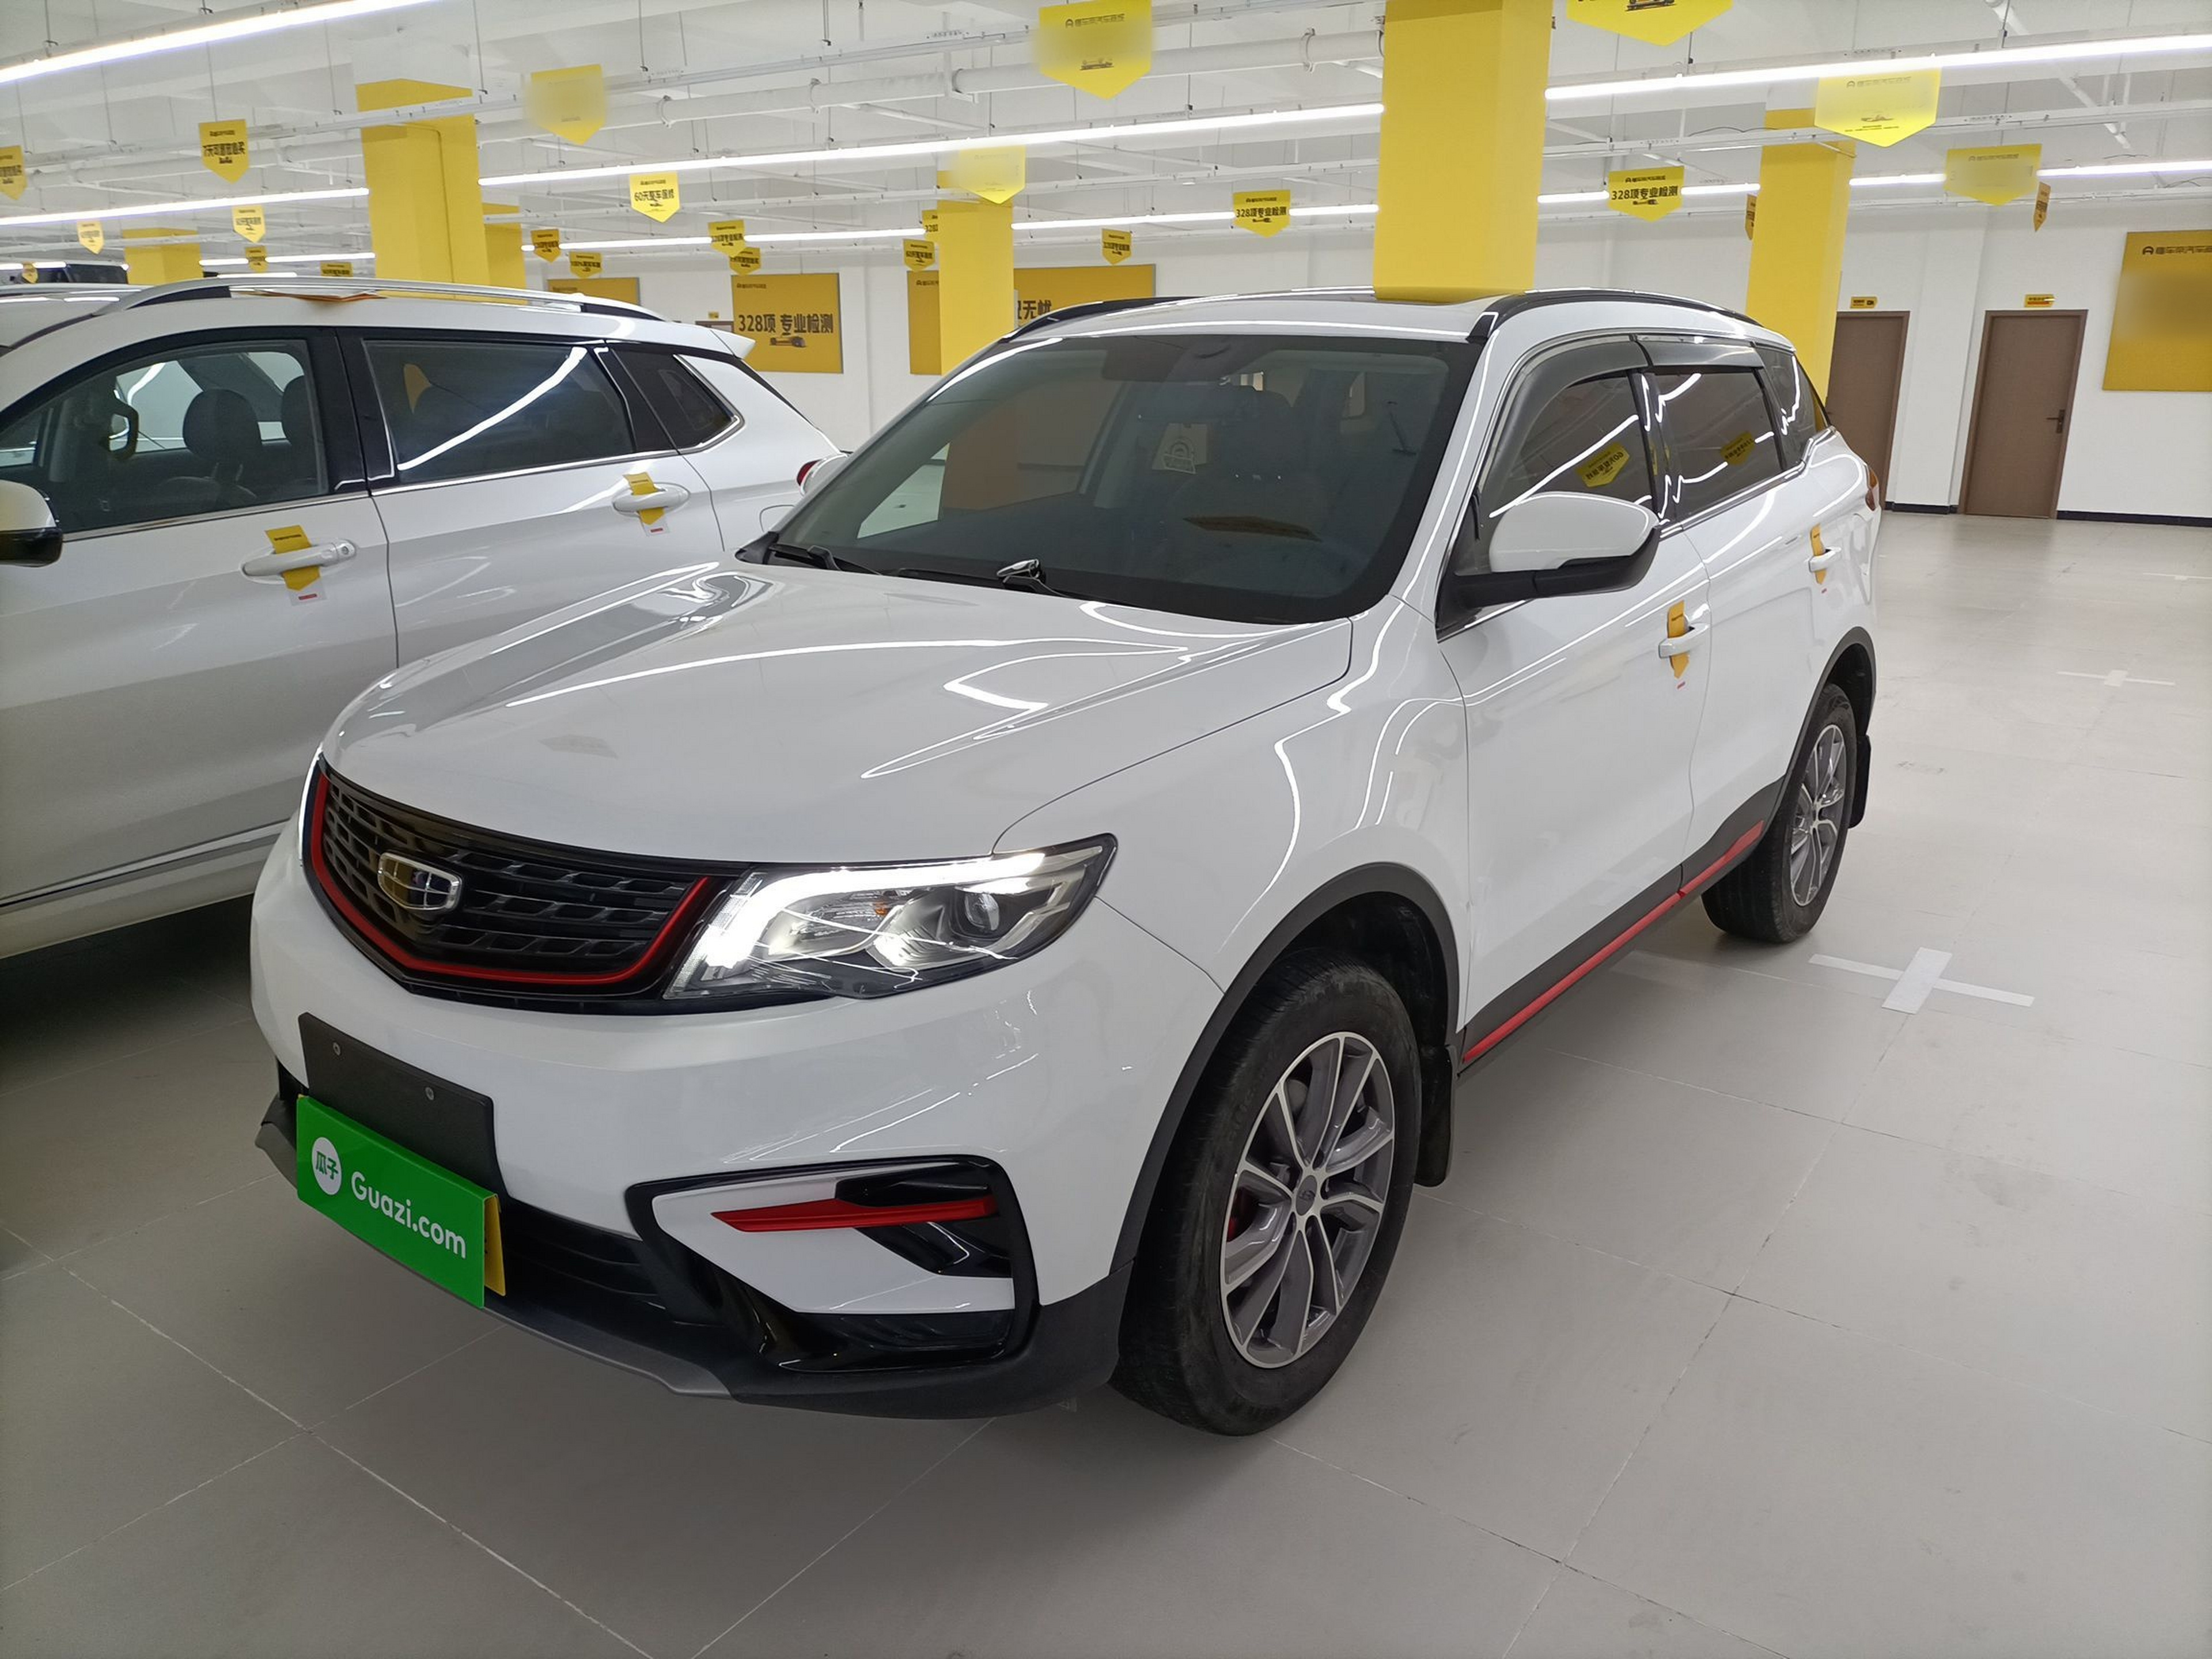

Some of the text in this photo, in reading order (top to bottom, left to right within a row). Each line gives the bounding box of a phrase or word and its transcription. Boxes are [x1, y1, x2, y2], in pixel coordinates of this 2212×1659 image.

[1611, 185, 1678, 200] 328项专业检测
[738, 313, 834, 336] 328项 专业检测
[315, 1150, 339, 1180] 瓜子
[351, 1171, 466, 1259] Guazi.com
